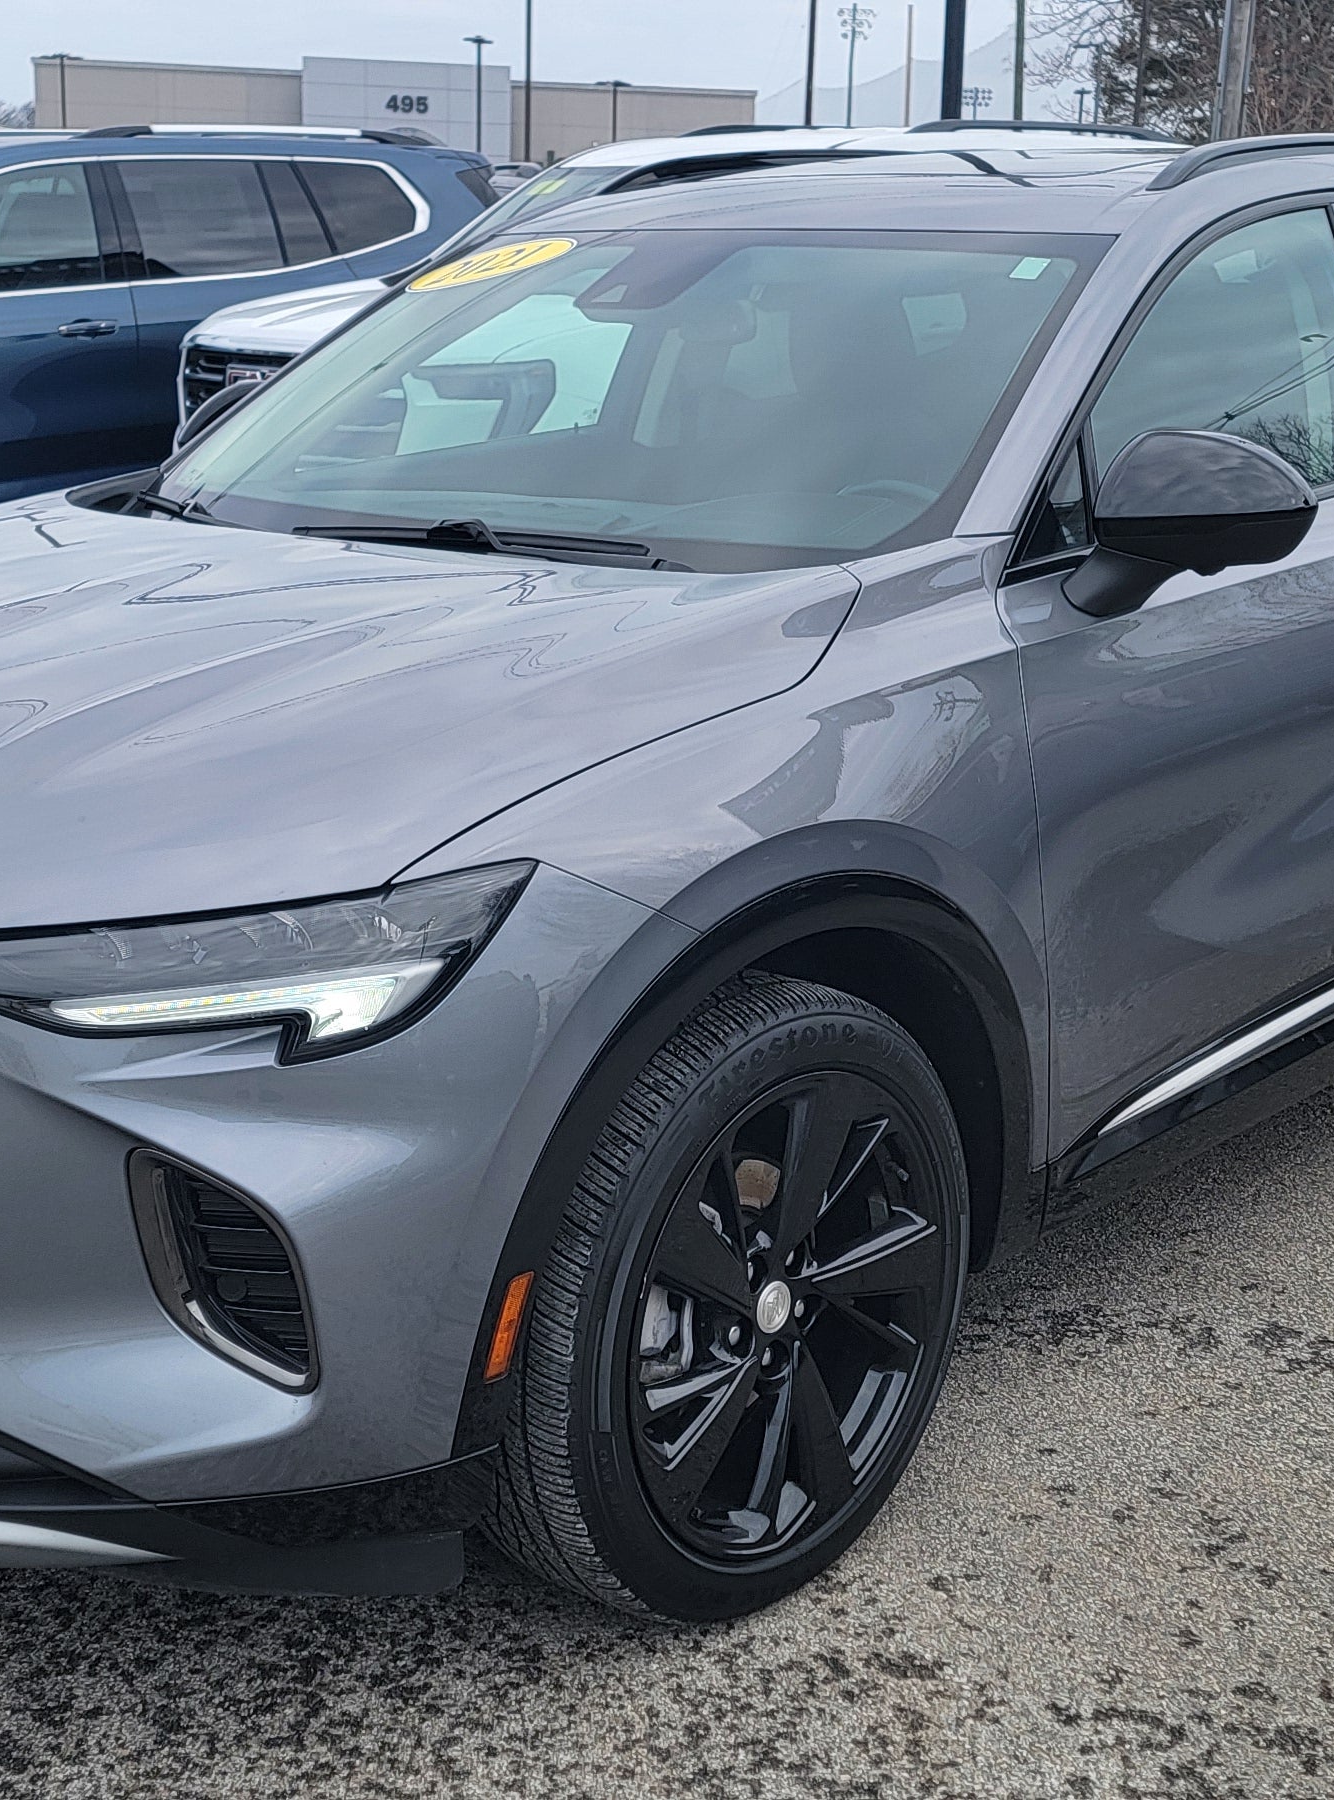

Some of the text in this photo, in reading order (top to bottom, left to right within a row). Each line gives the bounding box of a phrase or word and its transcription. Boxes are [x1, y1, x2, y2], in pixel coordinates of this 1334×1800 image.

[385, 95, 429, 114] 495
[422, 243, 553, 287] 2021
[698, 1022, 857, 1106] Firestone
